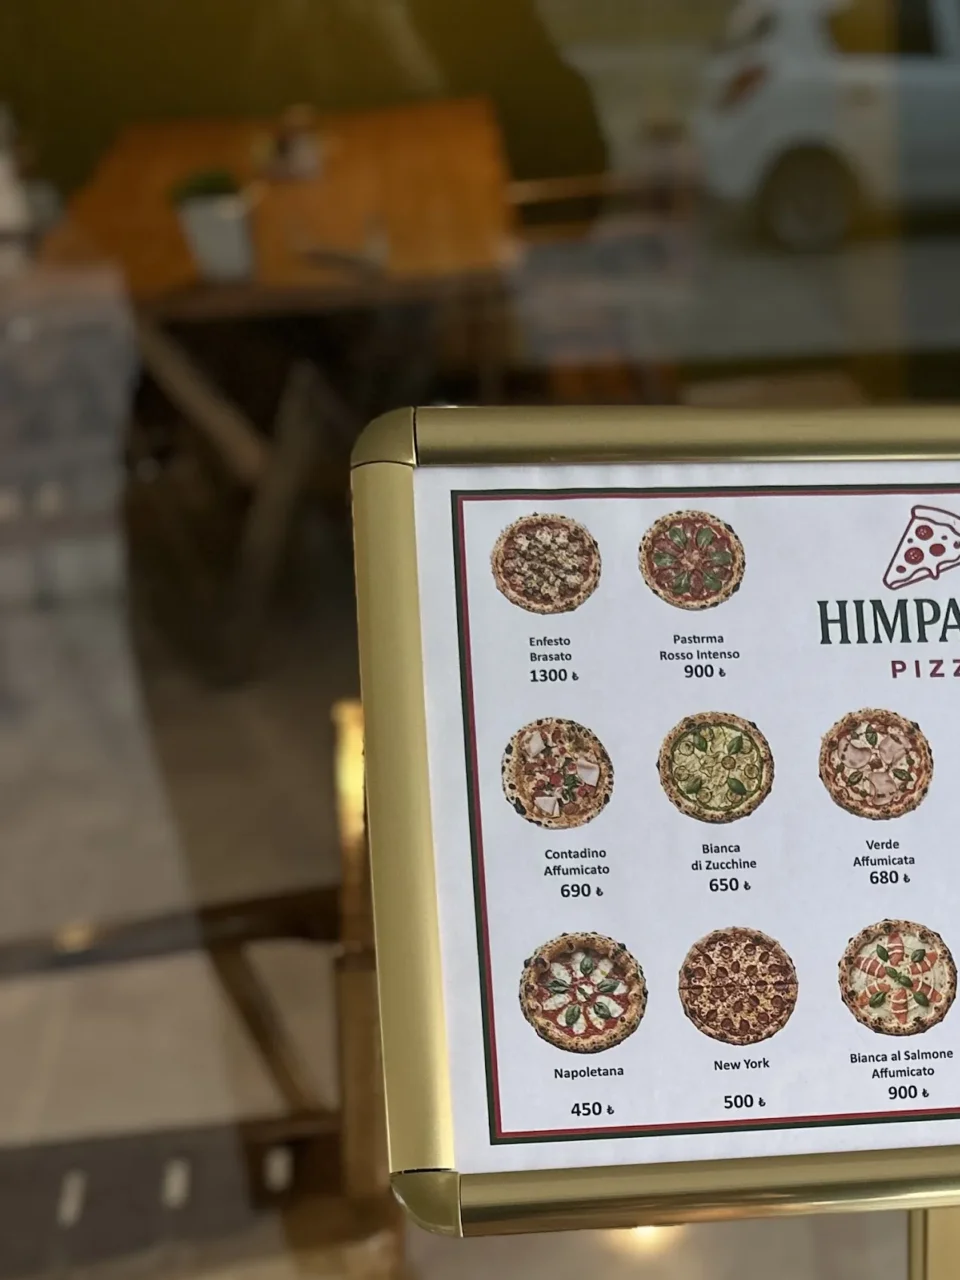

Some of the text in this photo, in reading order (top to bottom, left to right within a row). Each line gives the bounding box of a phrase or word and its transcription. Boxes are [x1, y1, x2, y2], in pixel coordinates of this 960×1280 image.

[529, 636, 570, 646] Enfesto
[530, 652, 572, 662] Brasato
[660, 650, 740, 660] Rosso Intenso
[530, 669, 567, 682] 1300
[684, 664, 714, 678] 900
[702, 843, 740, 854] Bianca
[866, 839, 899, 850] Verde
[545, 848, 606, 859] Contadino
[691, 858, 757, 871] di Zucchine
[853, 855, 915, 867] Affumicata
[544, 865, 610, 876] Affumicato
[870, 870, 899, 884] 680
[561, 883, 591, 898] 690
[709, 878, 739, 892] 650
[850, 1049, 953, 1063] Bianca al Salmone
[714, 1057, 770, 1070] New York
[554, 1066, 624, 1080] Napoletana
[872, 1067, 935, 1079] Affumicato
[888, 1085, 918, 1100] 900
[724, 1094, 754, 1109] 500
[571, 1102, 602, 1116] 450
